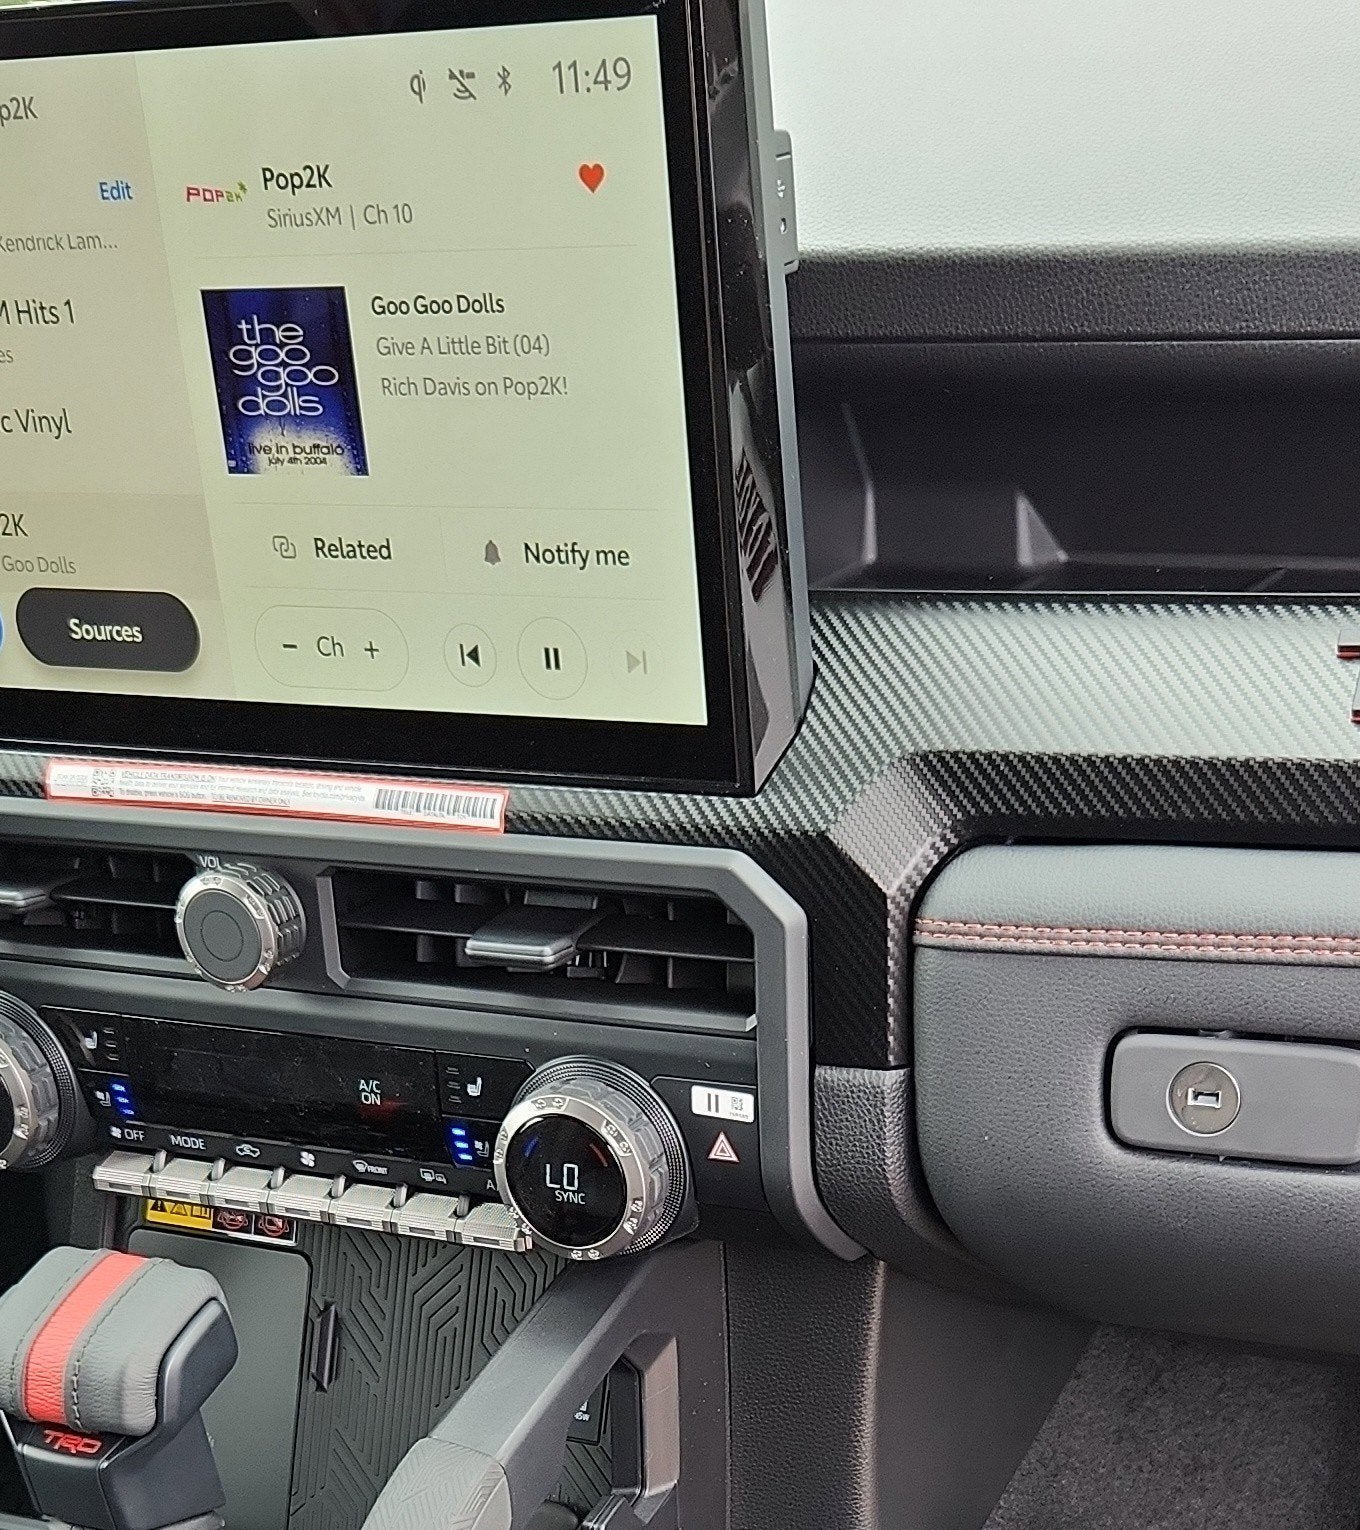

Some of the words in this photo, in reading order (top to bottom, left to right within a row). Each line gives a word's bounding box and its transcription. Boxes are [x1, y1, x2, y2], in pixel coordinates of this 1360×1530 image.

[552, 56, 632, 95] 11:49
[99, 181, 133, 201] Edit
[262, 164, 332, 194] Pop2K
[267, 206, 342, 230] SiriusXM
[364, 205, 389, 226] Ch
[393, 204, 412, 224] 10
[16, 300, 59, 325] Hits
[65, 299, 75, 324] 1
[371, 296, 409, 315] Goo
[414, 295, 454, 315] Goo
[457, 293, 505, 314] Dolls
[238, 315, 303, 344] the
[376, 336, 416, 356] Give
[420, 338, 433, 356] A
[438, 334, 481, 356] Little
[486, 334, 510, 355] Bit
[514, 334, 550, 358] (04)
[230, 345, 310, 375] goo
[258, 366, 339, 395] goo
[382, 376, 418, 398] Rich
[424, 376, 470, 398] Davis
[475, 382, 498, 397] on
[503, 375, 568, 400] Pop2K!
[239, 387, 323, 416] dolls
[15, 408, 72, 439] Vinyl
[249, 443, 272, 455] live
[276, 443, 288, 454] in
[292, 443, 345, 456] buffalo
[313, 537, 392, 562] Related
[524, 542, 589, 571] Notify
[596, 547, 630, 567] me
[2, 555, 34, 573] Goo
[37, 556, 76, 575] Dolls
[68, 619, 143, 643] Sources
[316, 636, 345, 658] Ch
[358, 1078, 382, 1095] A/C
[361, 1091, 381, 1106] ON
[124, 1128, 145, 1142] OFF
[170, 1134, 206, 1151] MODE
[545, 1162, 579, 1190] LO
[554, 1189, 586, 1206] SYNC
[43, 1429, 102, 1454] TRD
